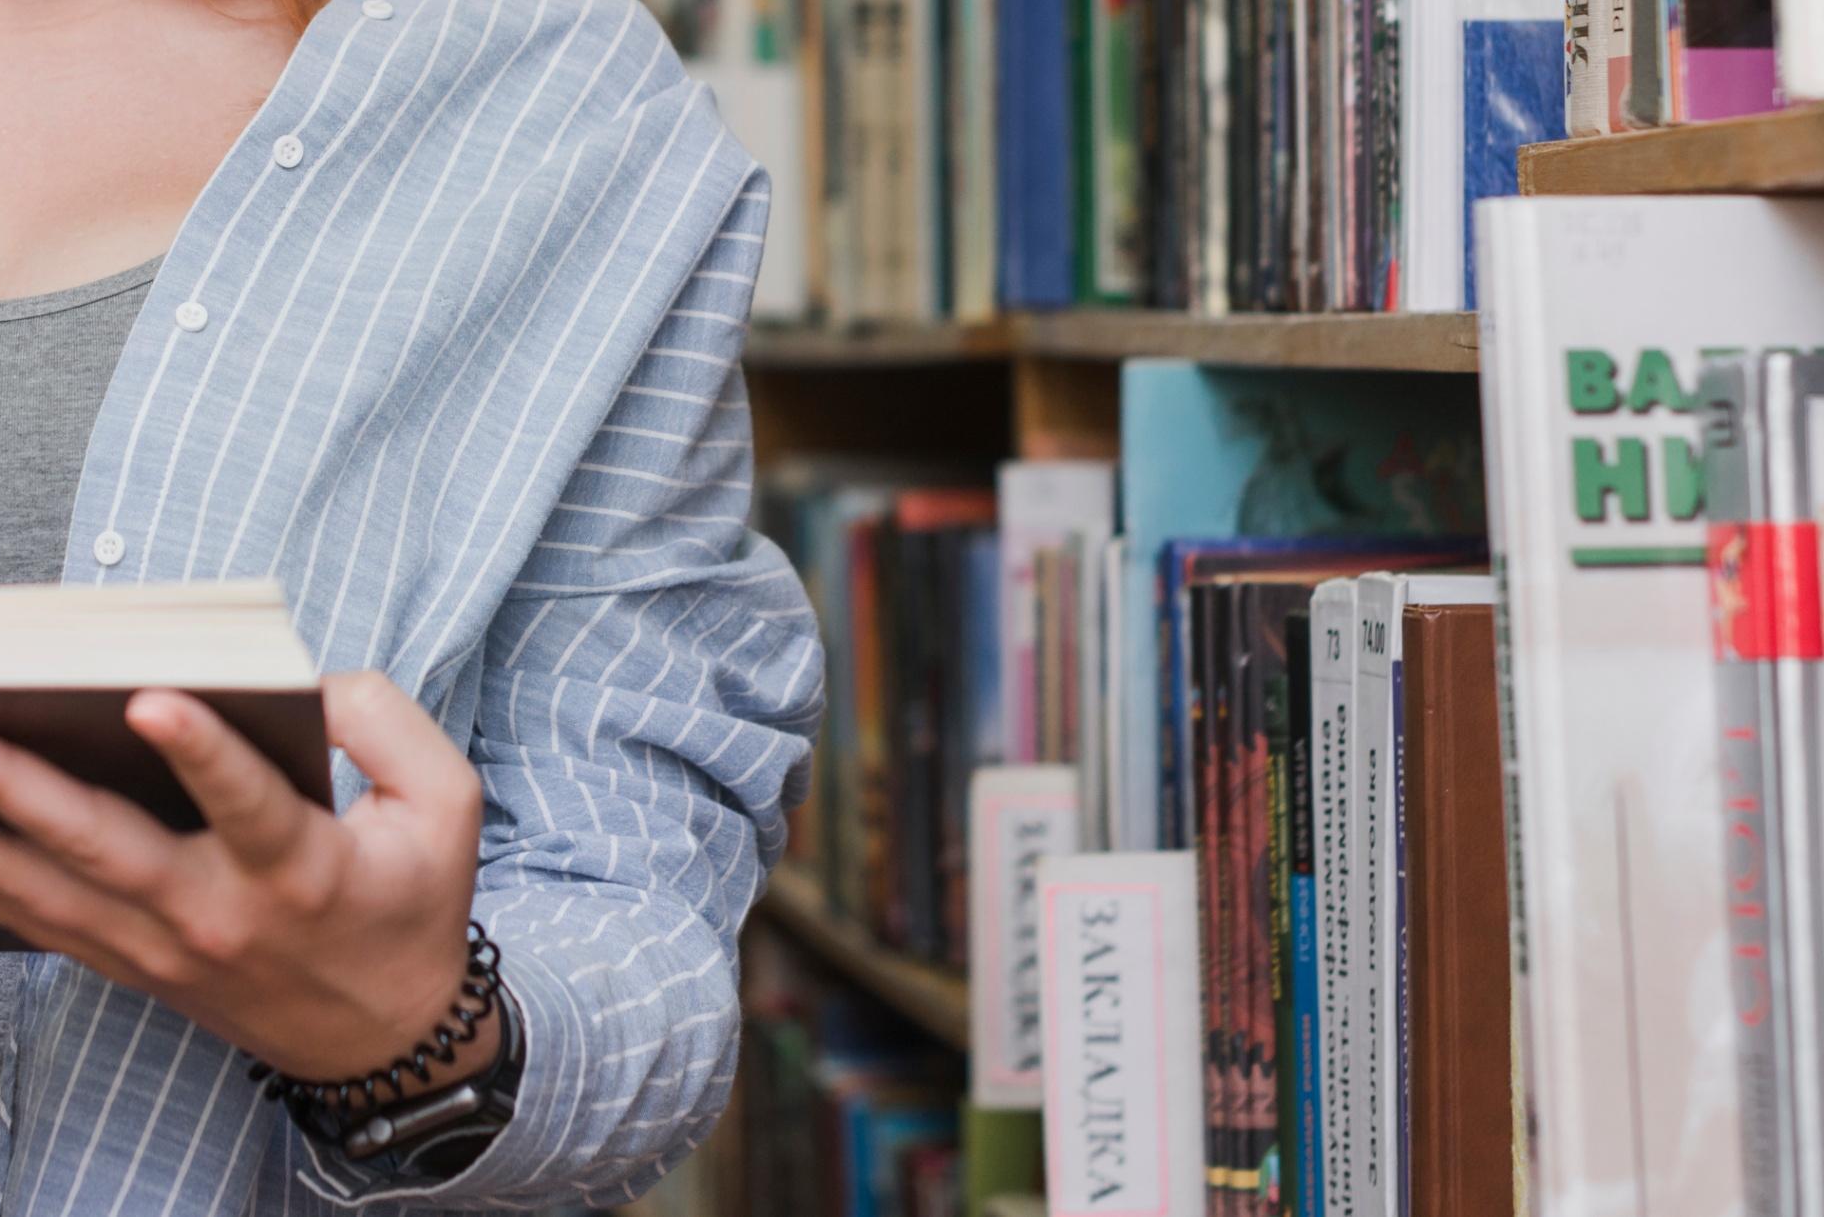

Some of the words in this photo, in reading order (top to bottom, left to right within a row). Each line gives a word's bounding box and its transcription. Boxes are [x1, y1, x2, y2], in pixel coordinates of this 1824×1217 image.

[1327, 629, 1340, 661] 73
[1362, 620, 1384, 654] 74.00
[1078, 899, 1125, 1203] ЗАКЛАДКА
